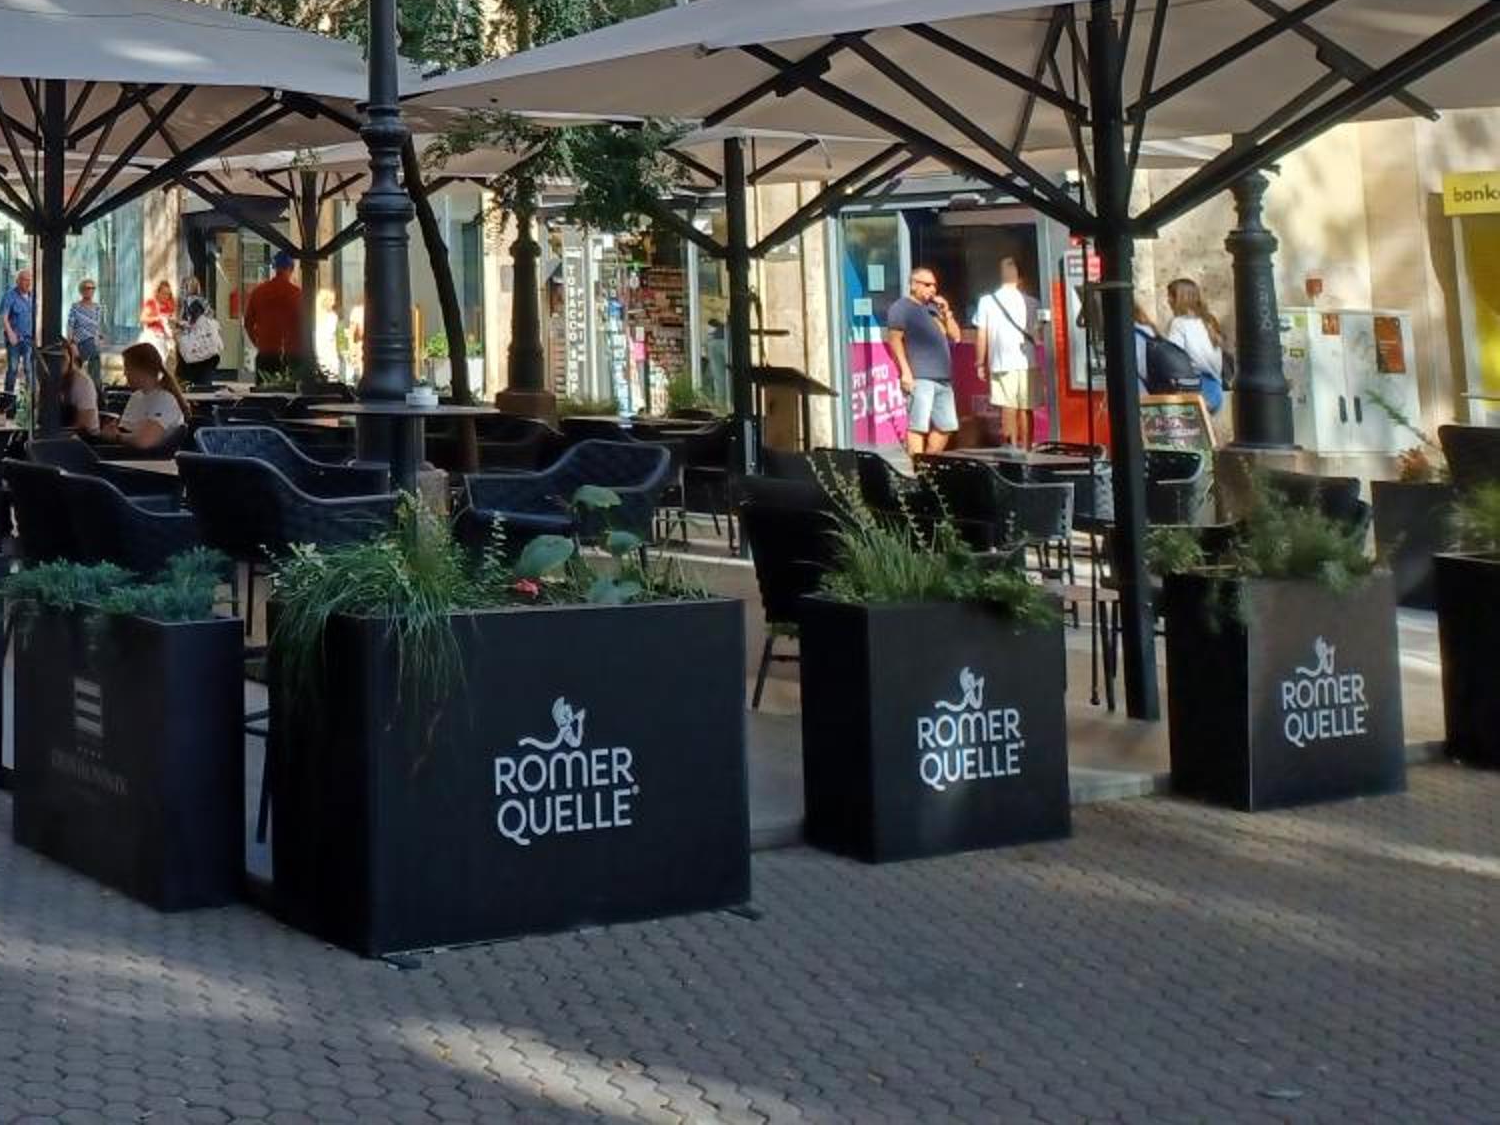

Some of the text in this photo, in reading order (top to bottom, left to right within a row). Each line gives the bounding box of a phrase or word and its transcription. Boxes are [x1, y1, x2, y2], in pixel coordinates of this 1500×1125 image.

[1284, 706, 1368, 748] QUELLE
[920, 741, 1022, 792] QUELLE
[497, 788, 634, 846] QUELLE
